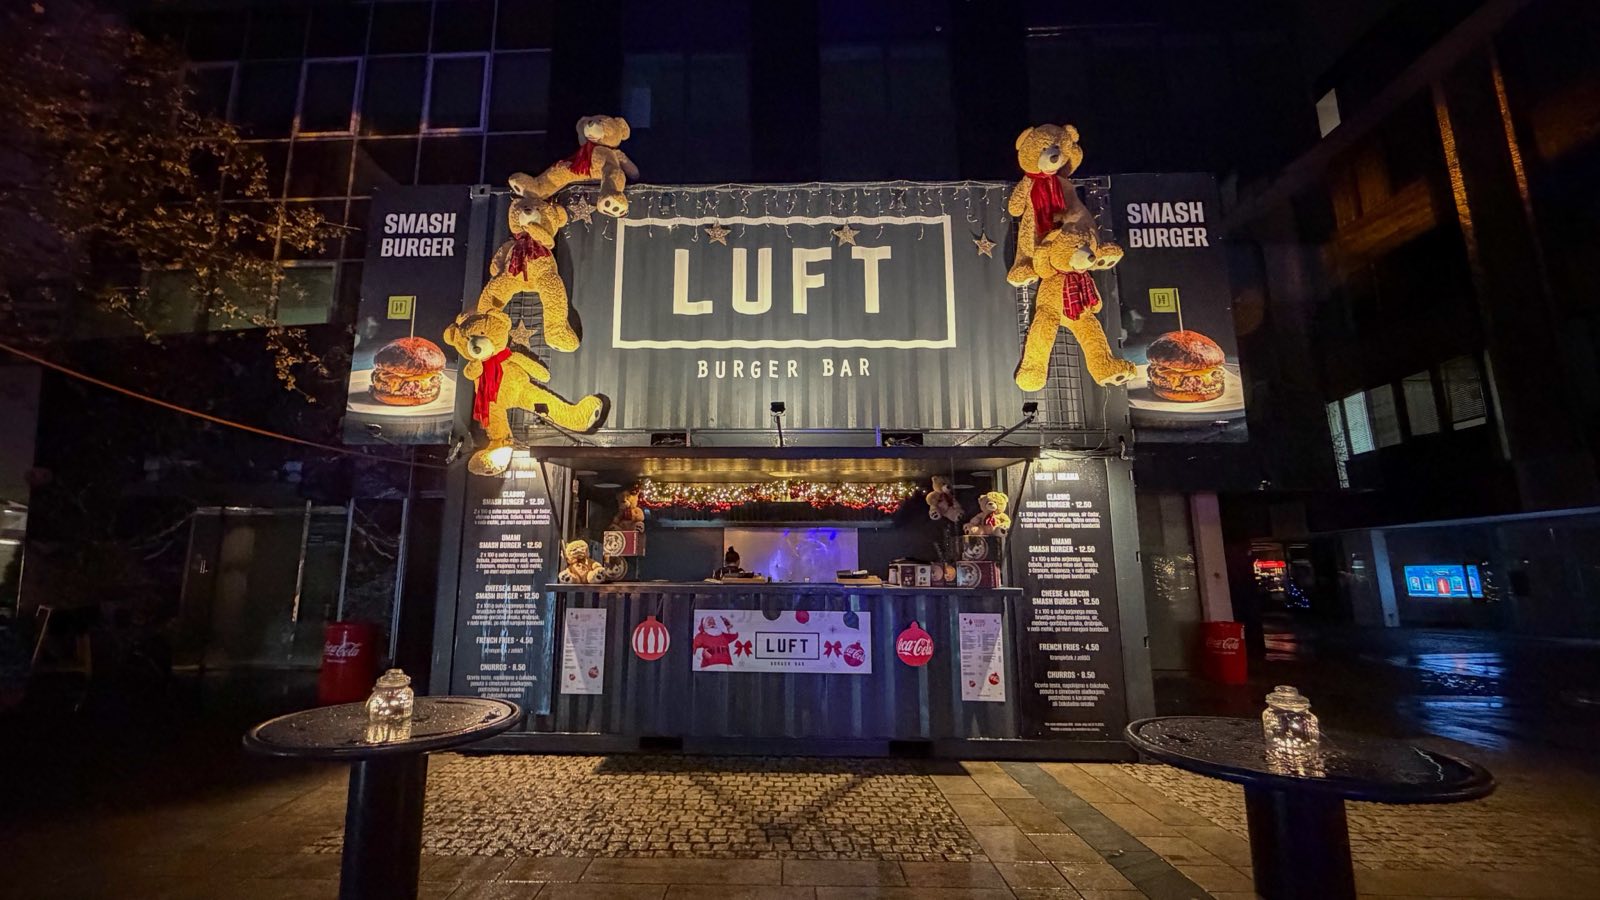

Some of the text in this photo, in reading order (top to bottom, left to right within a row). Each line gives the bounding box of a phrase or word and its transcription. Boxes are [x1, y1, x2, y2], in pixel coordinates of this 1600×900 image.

[1126, 202, 1204, 224] SMASH
[384, 213, 456, 234] SMASH
[381, 238, 454, 256] BURGER
[1128, 228, 1209, 248] BURGER
[673, 246, 891, 315] LUFT
[698, 358, 870, 378] BURGER BAR
[766, 638, 808, 653] LUFT
